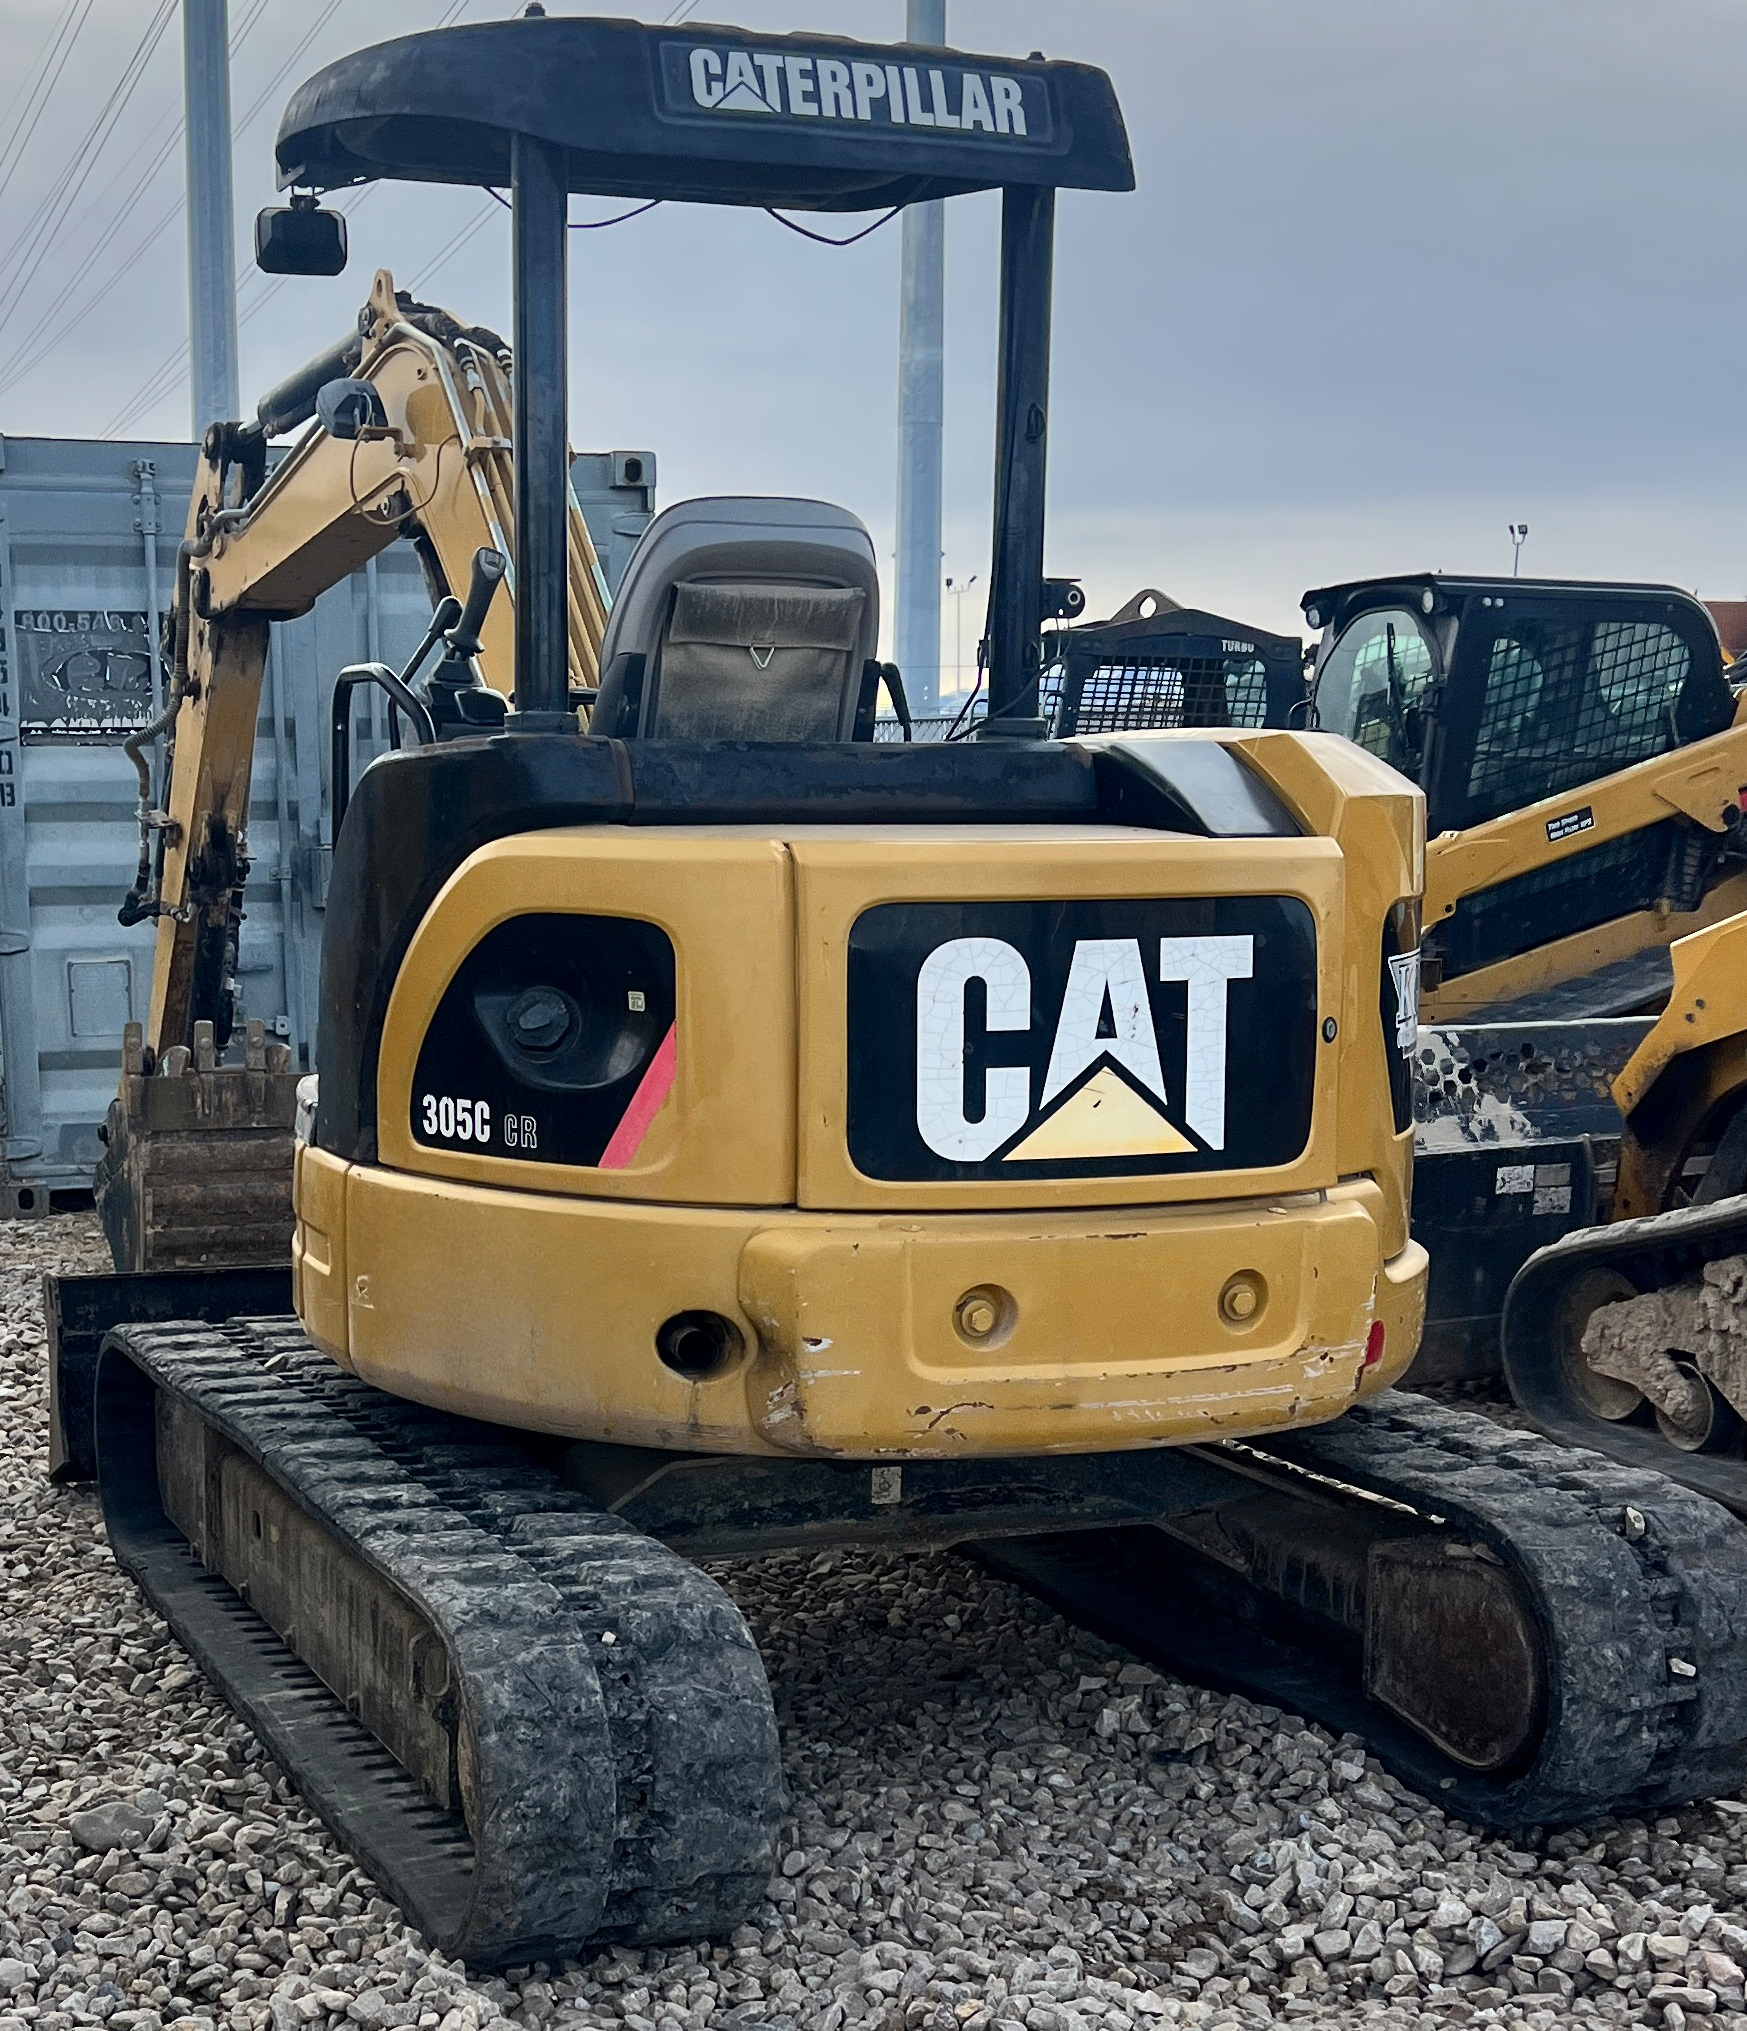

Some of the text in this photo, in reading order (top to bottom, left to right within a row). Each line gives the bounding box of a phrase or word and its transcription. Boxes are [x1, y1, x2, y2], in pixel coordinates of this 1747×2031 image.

[689, 48, 1027, 136] CATERPILLAR
[1221, 639, 1255, 653] TURBO
[916, 934, 1255, 1162] CAT
[422, 1093, 538, 1149] 305C CR
